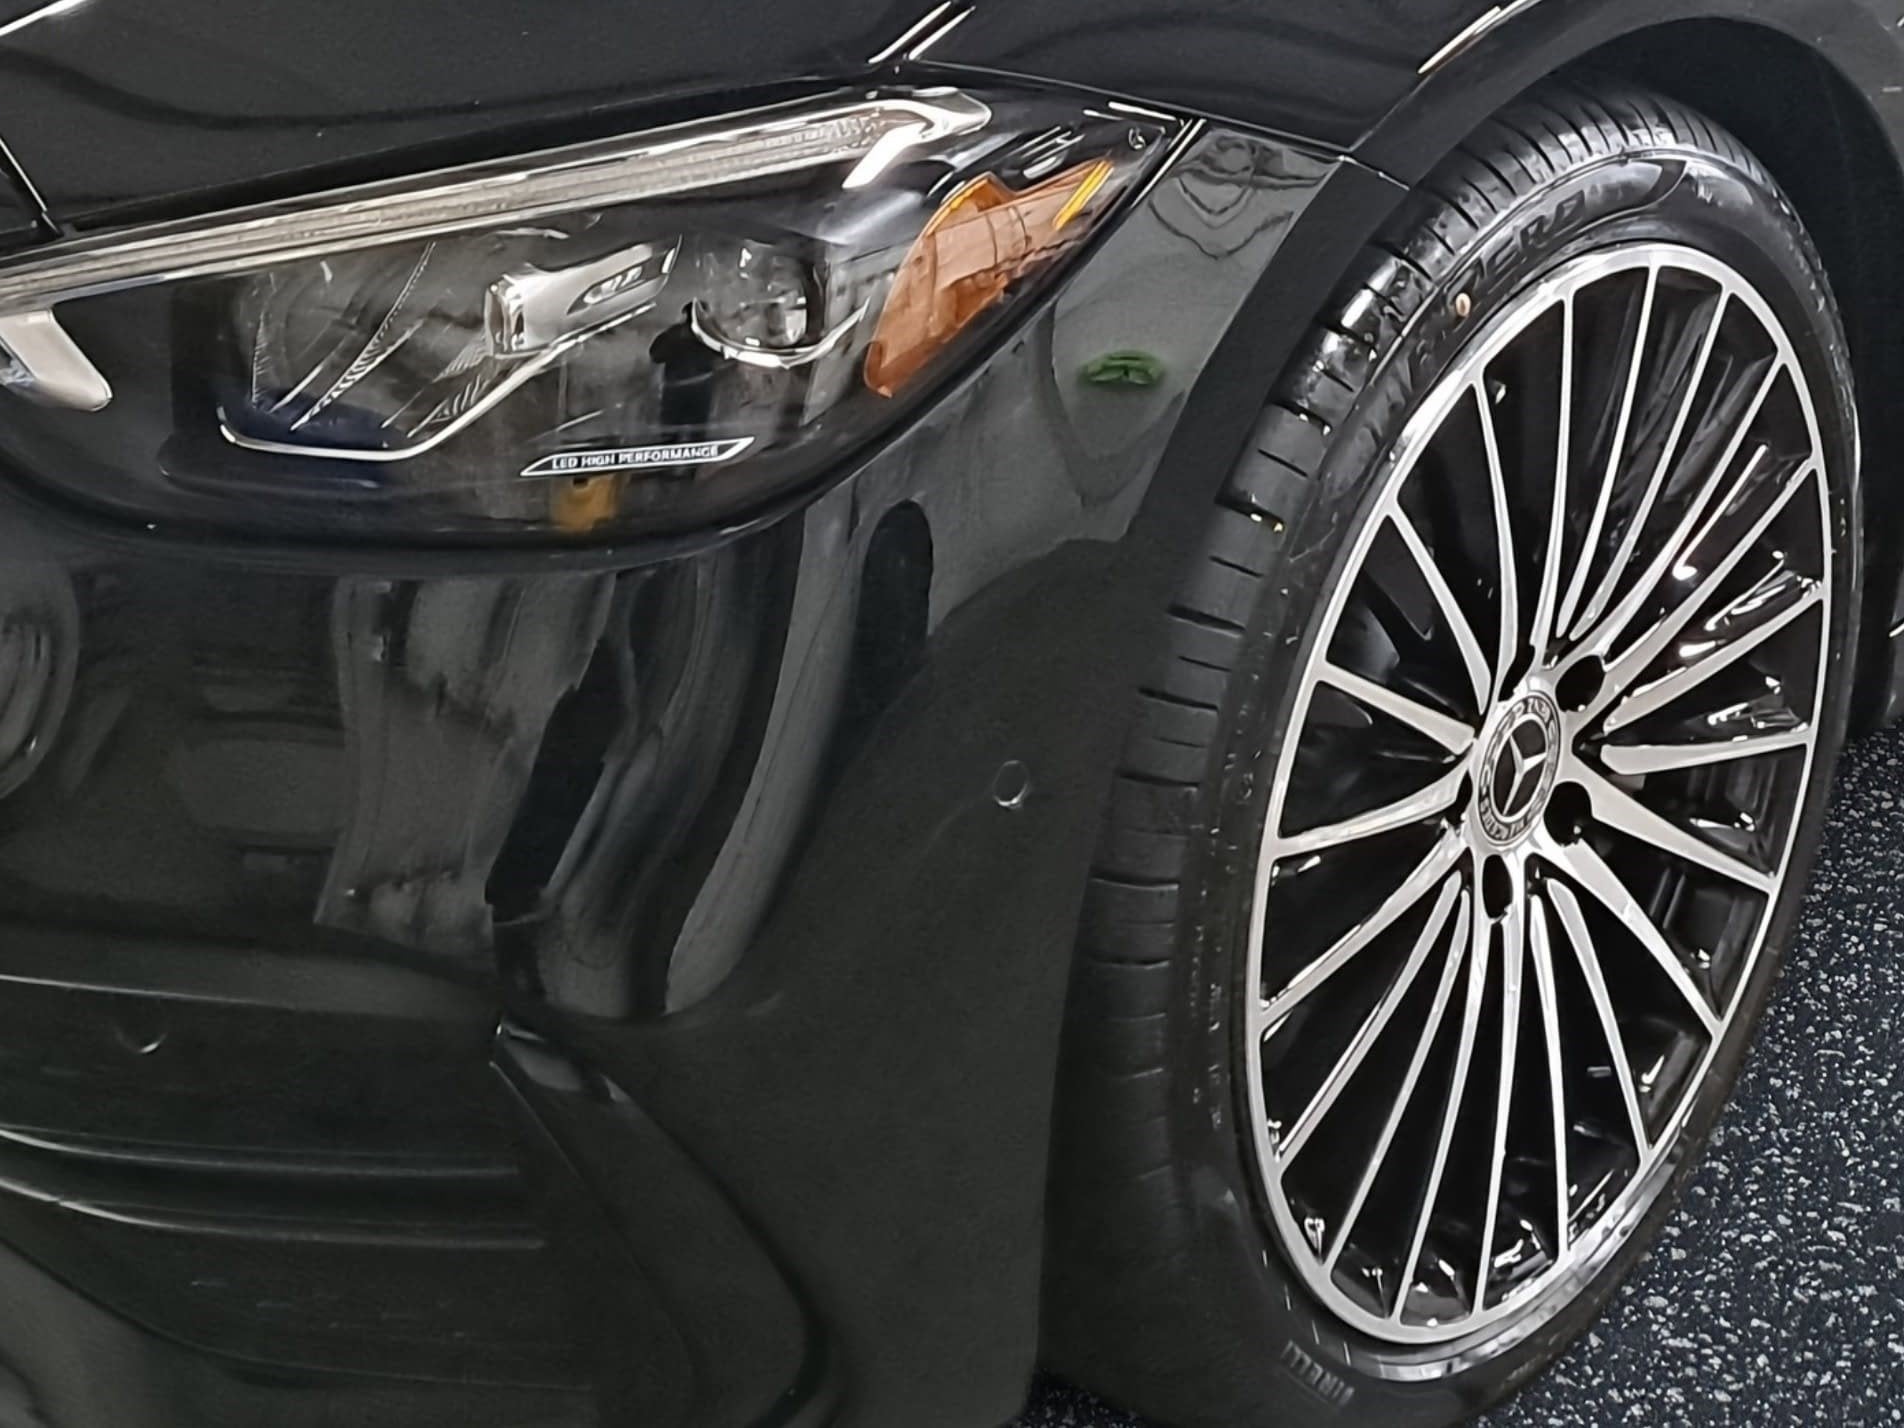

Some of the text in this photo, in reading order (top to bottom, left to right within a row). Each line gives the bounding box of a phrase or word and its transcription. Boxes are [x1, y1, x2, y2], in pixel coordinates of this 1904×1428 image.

[551, 444, 721, 471] LED HIGH PERFORMANCE
